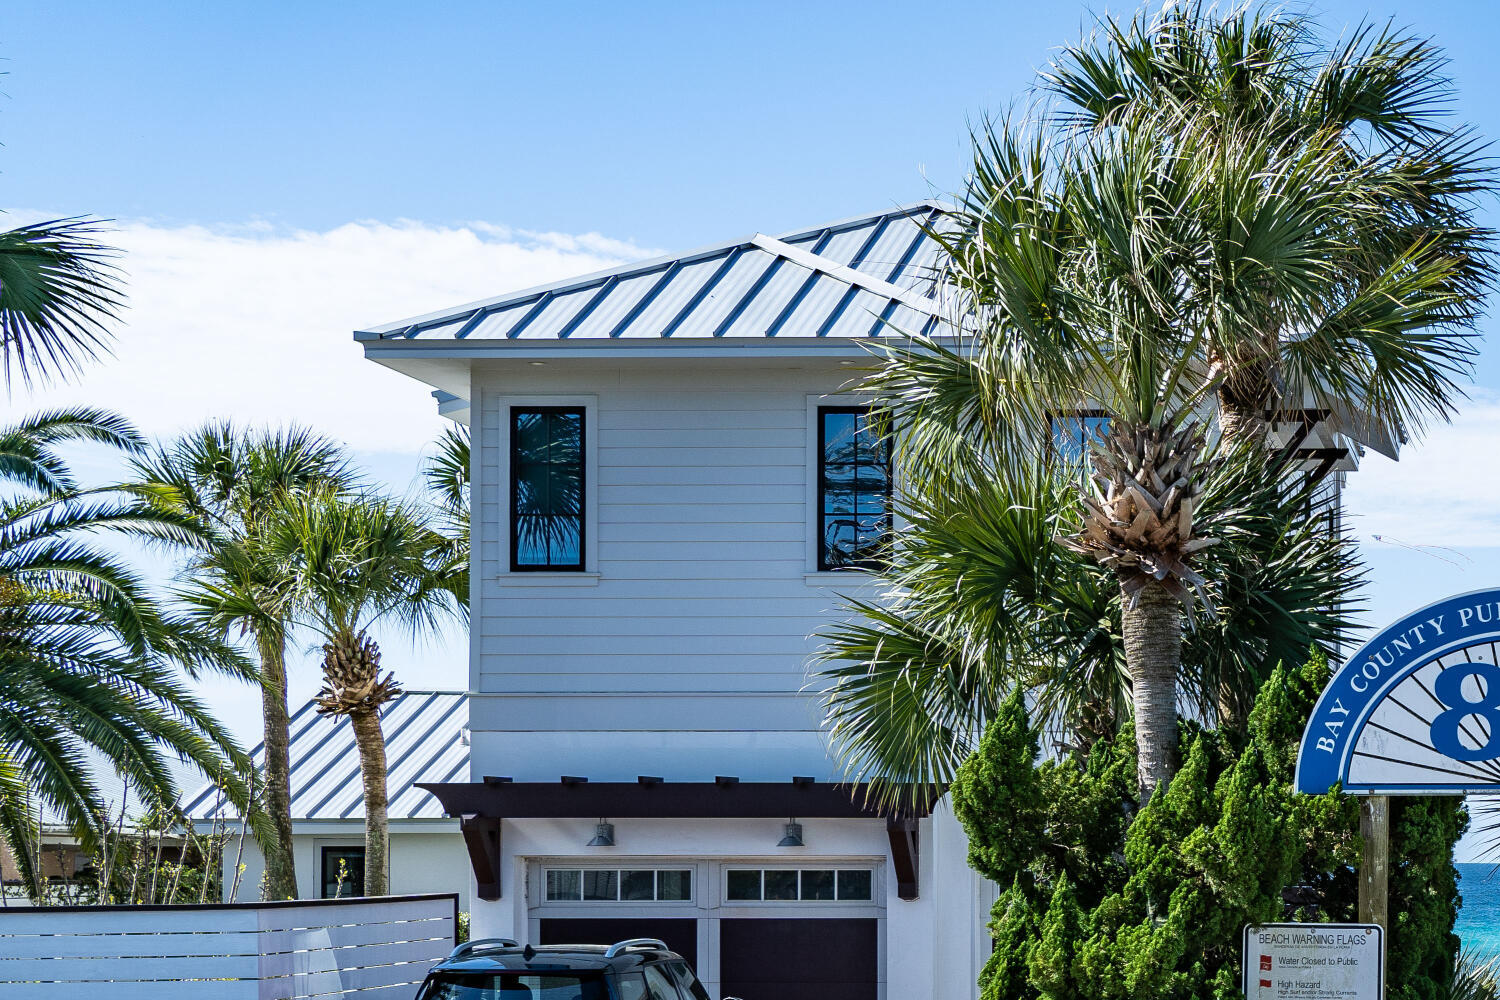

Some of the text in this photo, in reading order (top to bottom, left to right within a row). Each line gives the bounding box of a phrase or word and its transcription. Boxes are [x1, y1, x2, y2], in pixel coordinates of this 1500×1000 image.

[1316, 698, 1350, 755] BAY
[1350, 615, 1446, 693] COUNTY
[1259, 934, 1366, 945] BEACH WARNING FLAGS
[1279, 957, 1358, 965] Water Closed to Public
[1278, 980, 1294, 988] High
